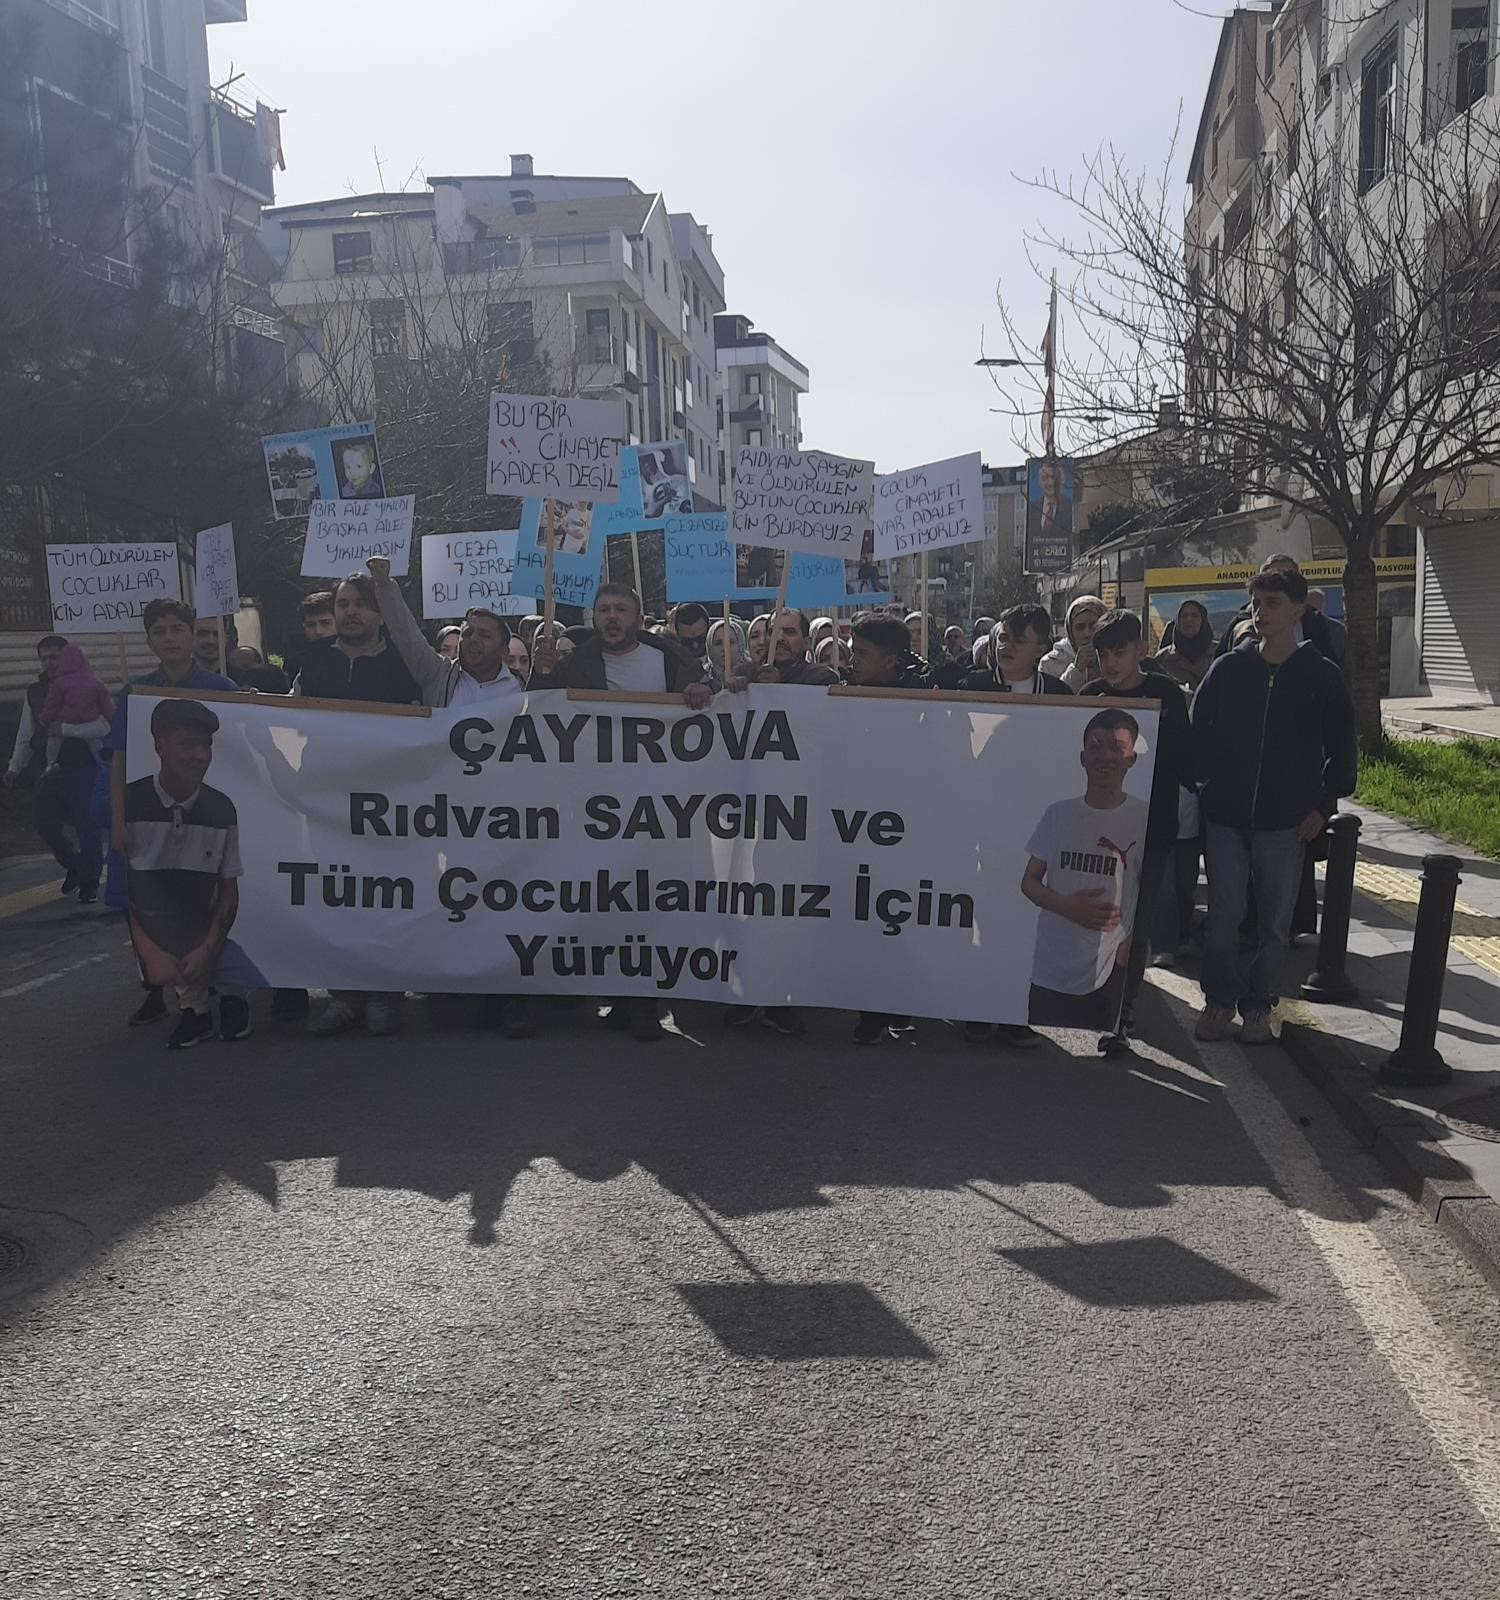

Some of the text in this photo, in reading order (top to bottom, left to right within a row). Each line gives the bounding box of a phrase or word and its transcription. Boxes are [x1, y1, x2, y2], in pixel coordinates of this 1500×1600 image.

[495, 400, 572, 430] BU BİR
[539, 433, 623, 461] CİNAYET
[491, 460, 560, 487] KADER
[740, 449, 864, 480] RIDVAN SAYGIN
[737, 472, 757, 485] VE
[313, 500, 336, 517] BİR
[344, 501, 370, 517] AİLE
[877, 498, 966, 536] VAR ADALET
[48, 549, 87, 567] TÜM
[326, 540, 405, 563] YIKILMASIN
[454, 539, 498, 558] CEZA
[62, 568, 166, 596] COCUKLAR
[453, 562, 464, 576] 7
[432, 583, 458, 602] BU
[535, 584, 587, 603] AALET
[93, 601, 147, 622] ADALE
[449, 709, 801, 775] ÇAYIROVA
[349, 792, 905, 845] Rıdvan SAYGIN ve
[1060, 851, 1118, 877] PUMA
[278, 862, 975, 936] Tüm Çocuklarımız İçin
[506, 934, 737, 989] Yürüyor
